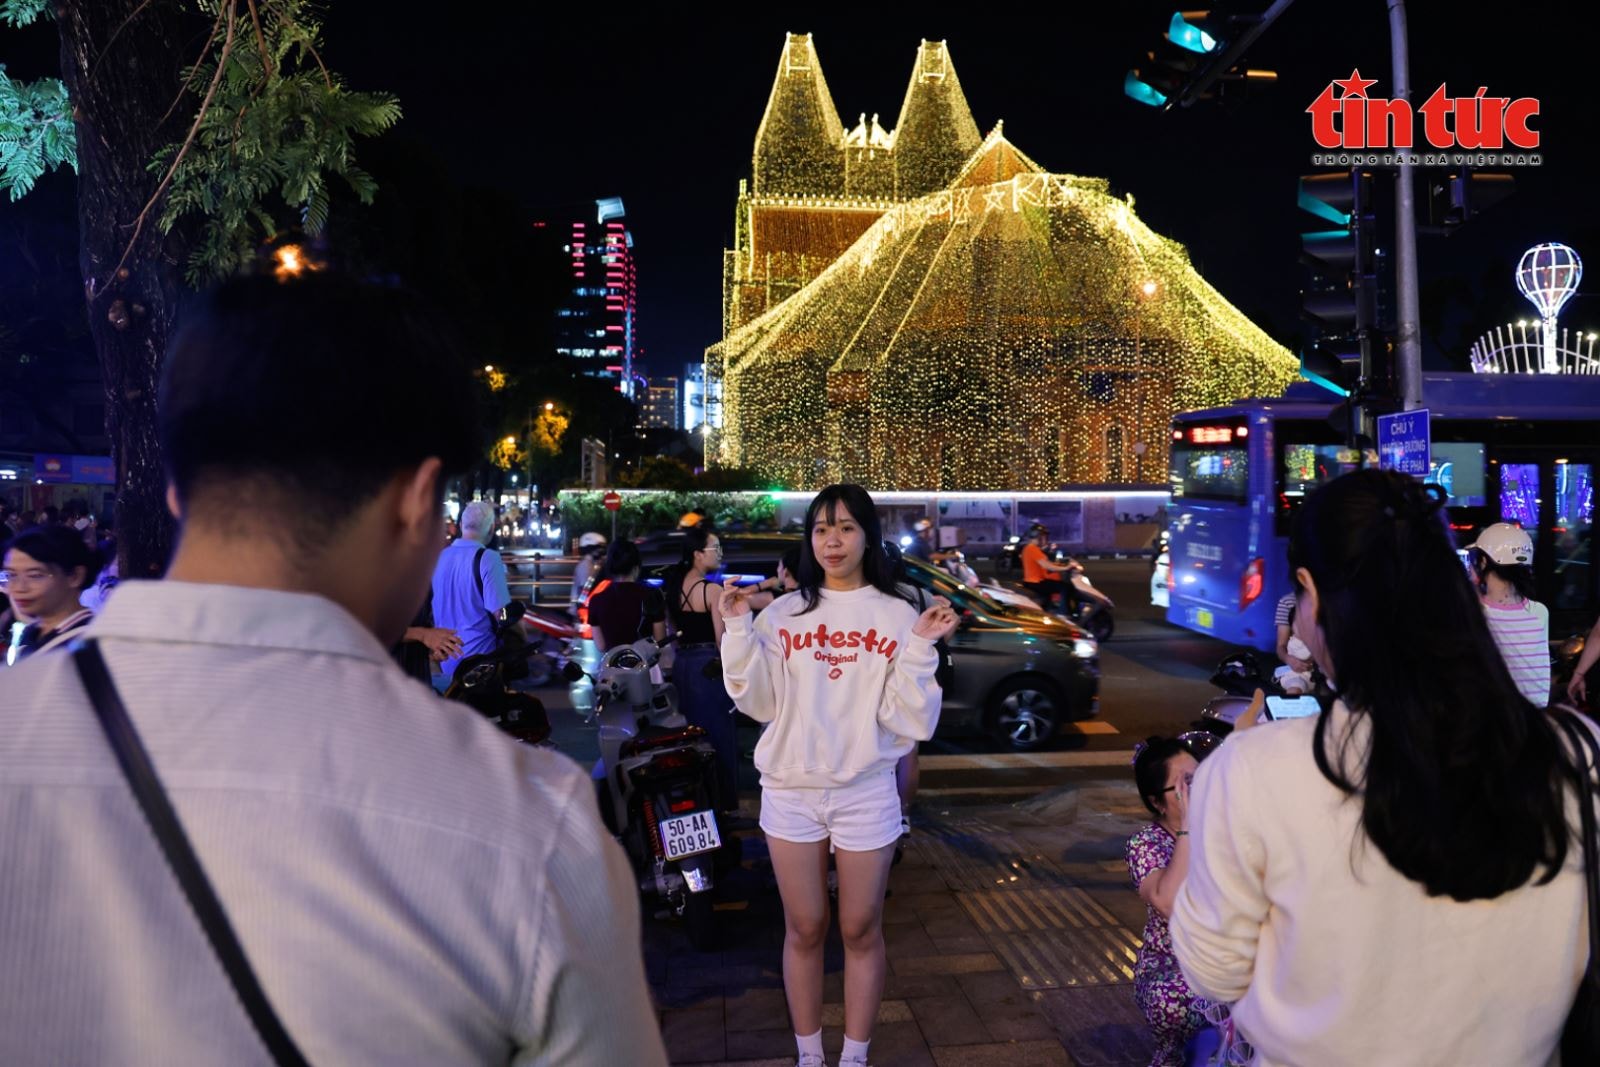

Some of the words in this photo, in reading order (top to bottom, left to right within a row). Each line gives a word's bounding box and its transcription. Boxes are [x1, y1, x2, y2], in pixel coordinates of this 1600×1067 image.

[813, 650, 858, 667] Original
[667, 814, 708, 837] 50-AA
[668, 830, 716, 856] 609.84
